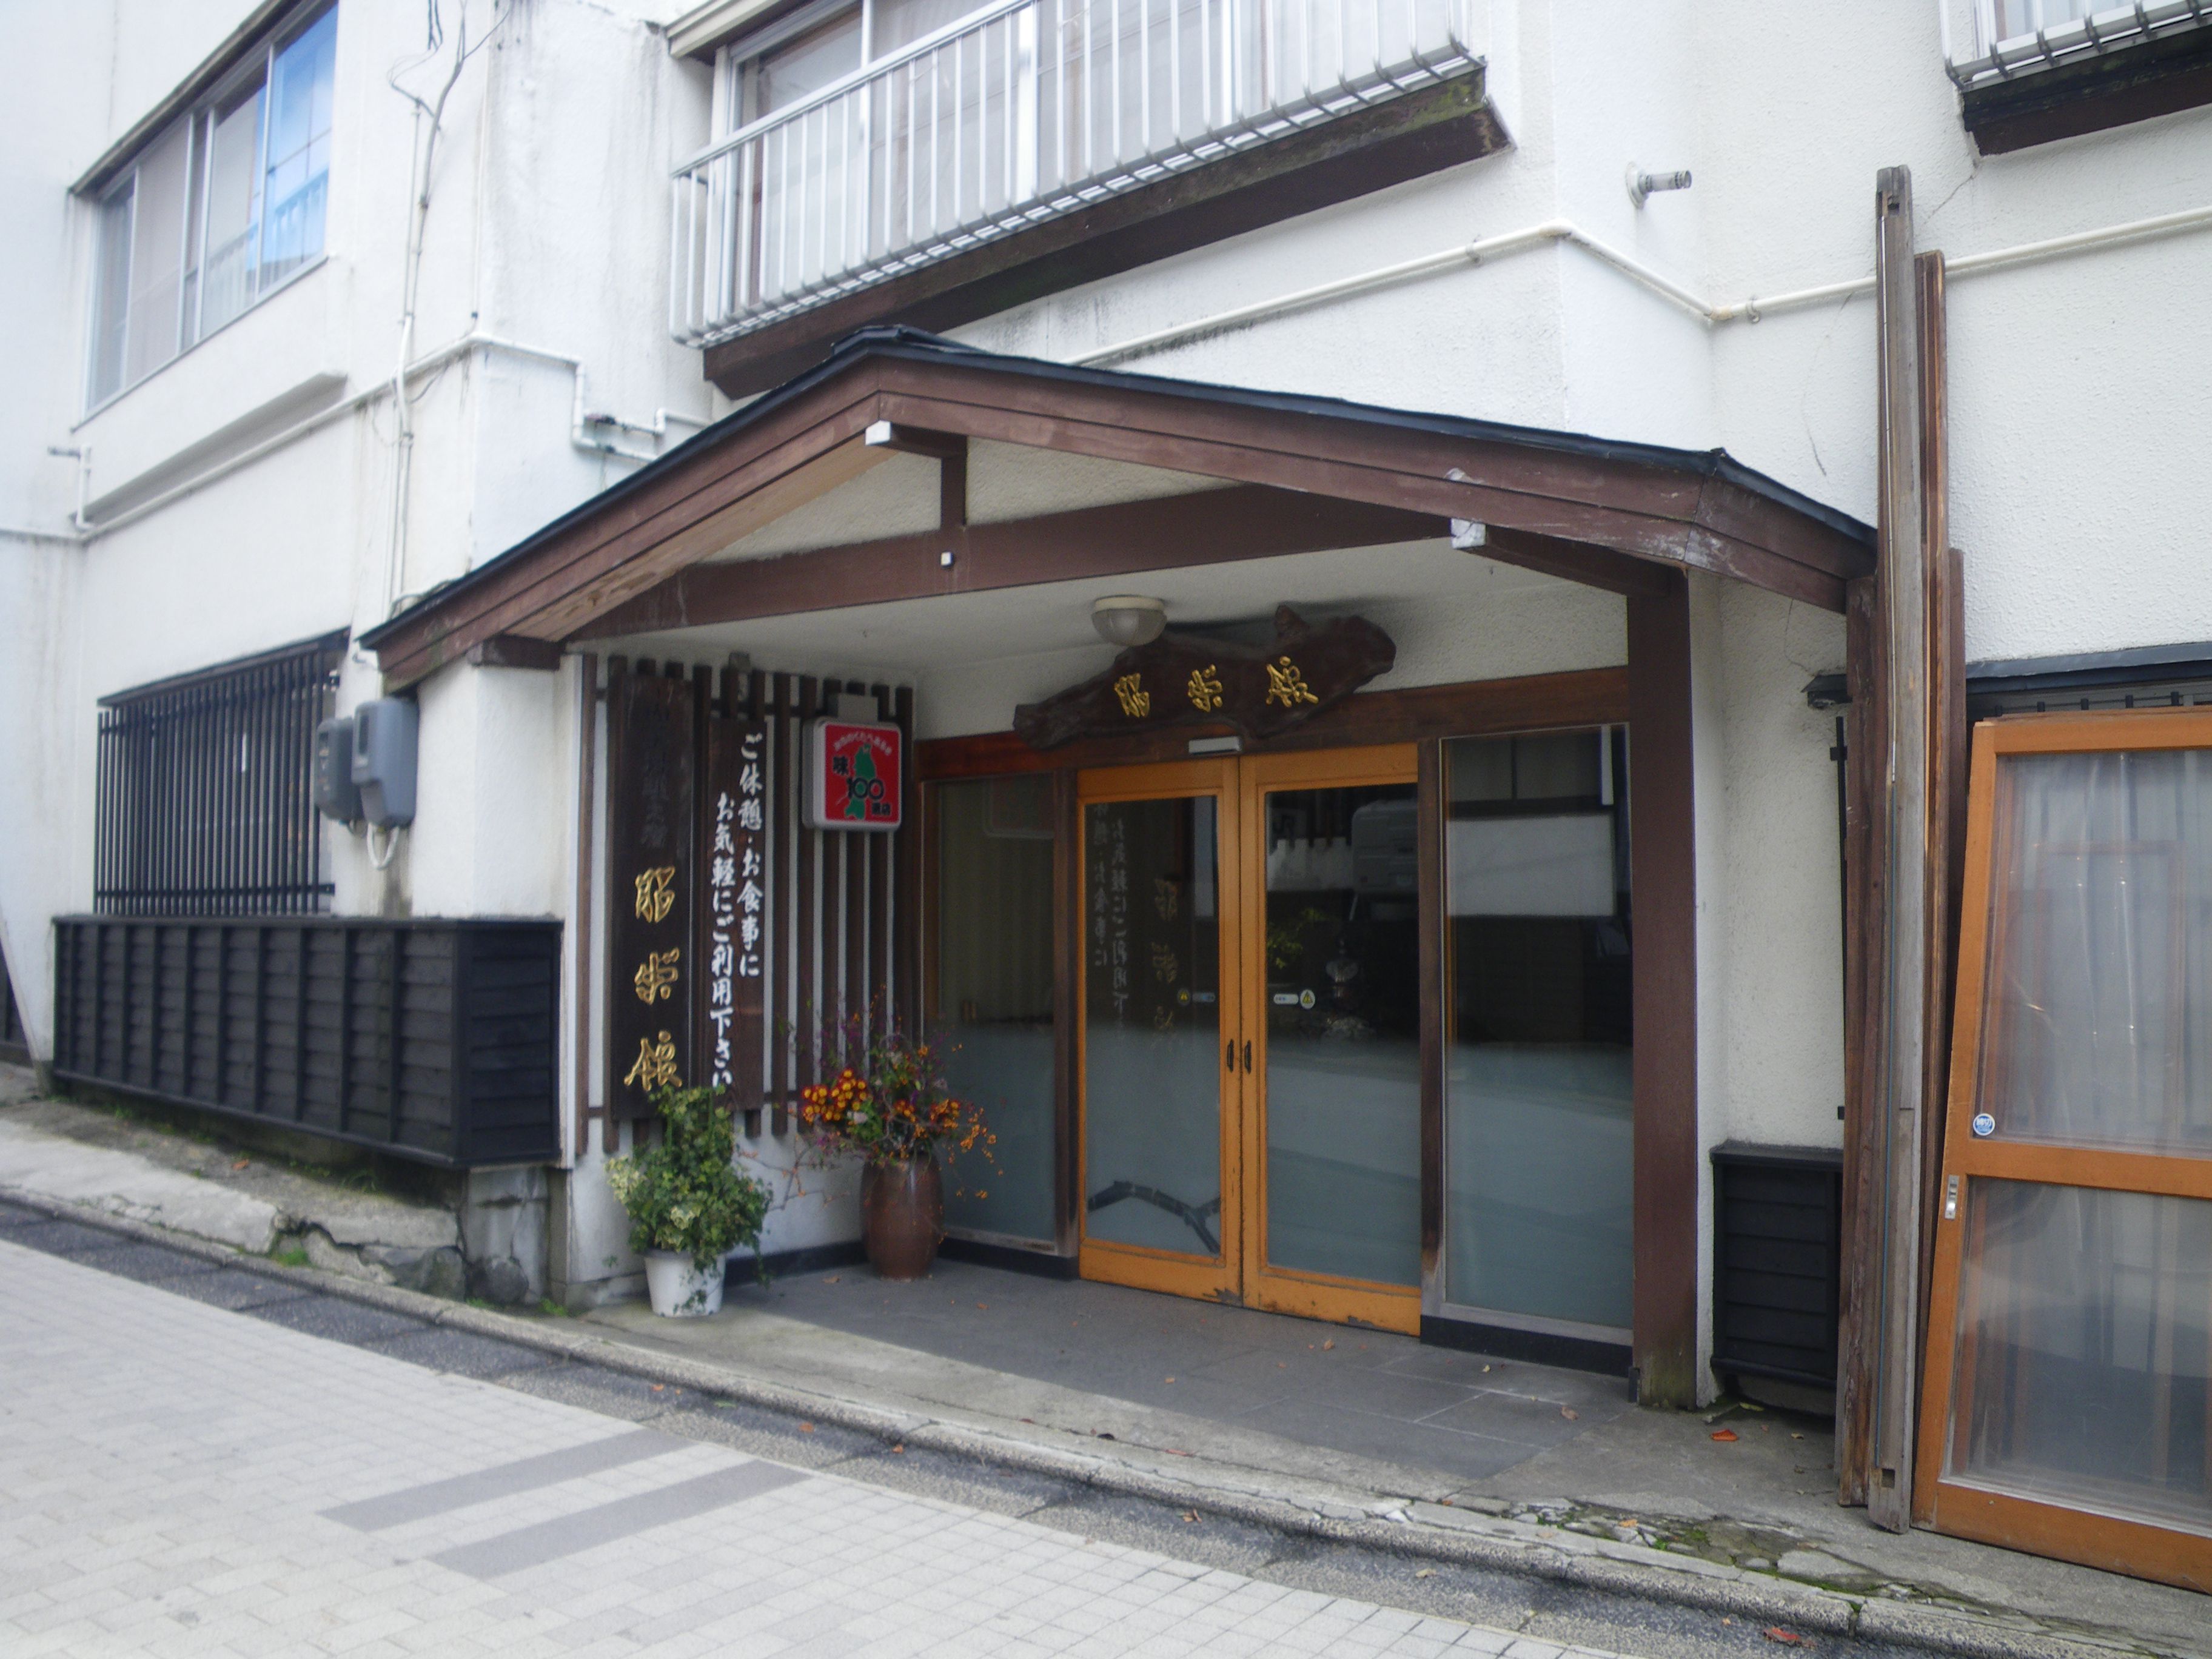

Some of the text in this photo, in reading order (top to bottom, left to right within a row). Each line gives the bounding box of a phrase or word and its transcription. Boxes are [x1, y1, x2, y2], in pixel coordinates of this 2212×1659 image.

[833, 756, 848, 776] 味
[847, 777, 884, 800] 100
[737, 732, 763, 977] ご休憩・お食事に
[710, 790, 736, 1088] お気軽にご利用下さい
